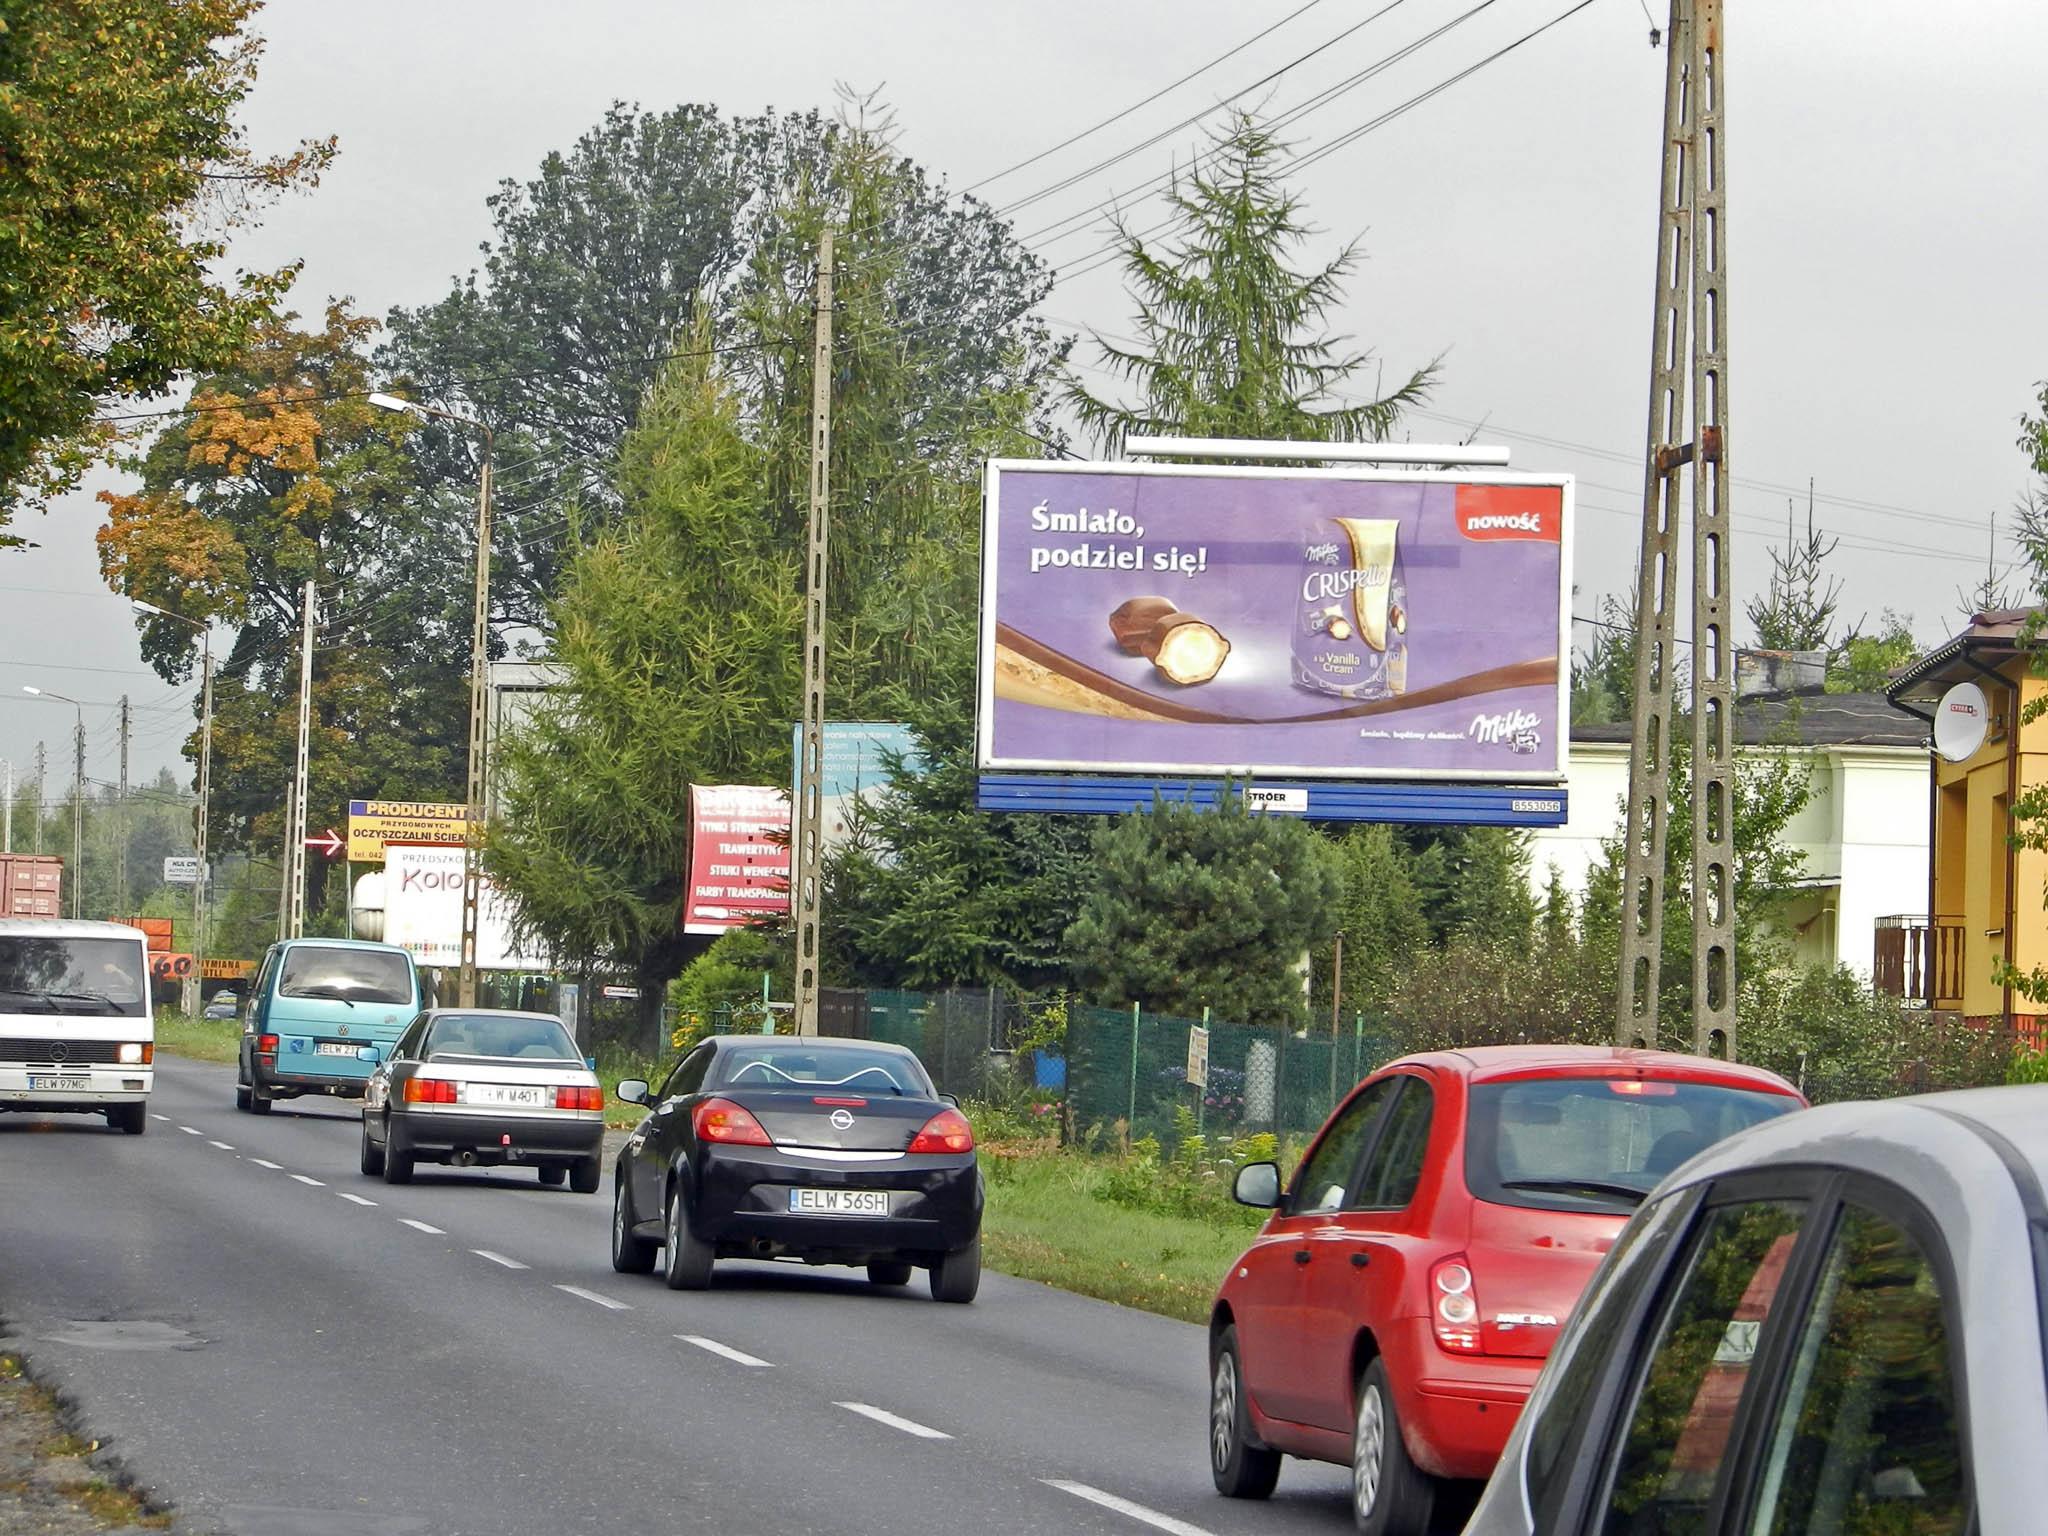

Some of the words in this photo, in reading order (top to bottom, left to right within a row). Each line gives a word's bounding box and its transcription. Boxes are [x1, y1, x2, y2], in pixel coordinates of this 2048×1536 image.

[1031, 499, 1145, 538] Śmiało,
[1467, 512, 1541, 532] nowość
[1031, 543, 1144, 573] podziel
[1153, 547, 1207, 578] się!
[1326, 652, 1360, 665] Vanilla
[1322, 662, 1354, 674] Cream
[1469, 708, 1542, 744] Milka
[366, 803, 467, 819] PRODUCENT
[1514, 801, 1560, 812] 8553056
[381, 820, 451, 829] PRZYDOMOWYCH
[353, 829, 431, 841] OCZYSZCZALNI
[368, 851, 383, 859] 042
[719, 843, 783, 855] TRAWERTYNY
[709, 864, 740, 876] STIUKI
[696, 886, 726, 897] FARBY
[36, 1079, 57, 1089] ELW
[60, 1080, 85, 1089] 97MG
[509, 1090, 538, 1103] M401
[801, 1191, 838, 1209] ELW
[843, 1192, 885, 1211] 56SH
